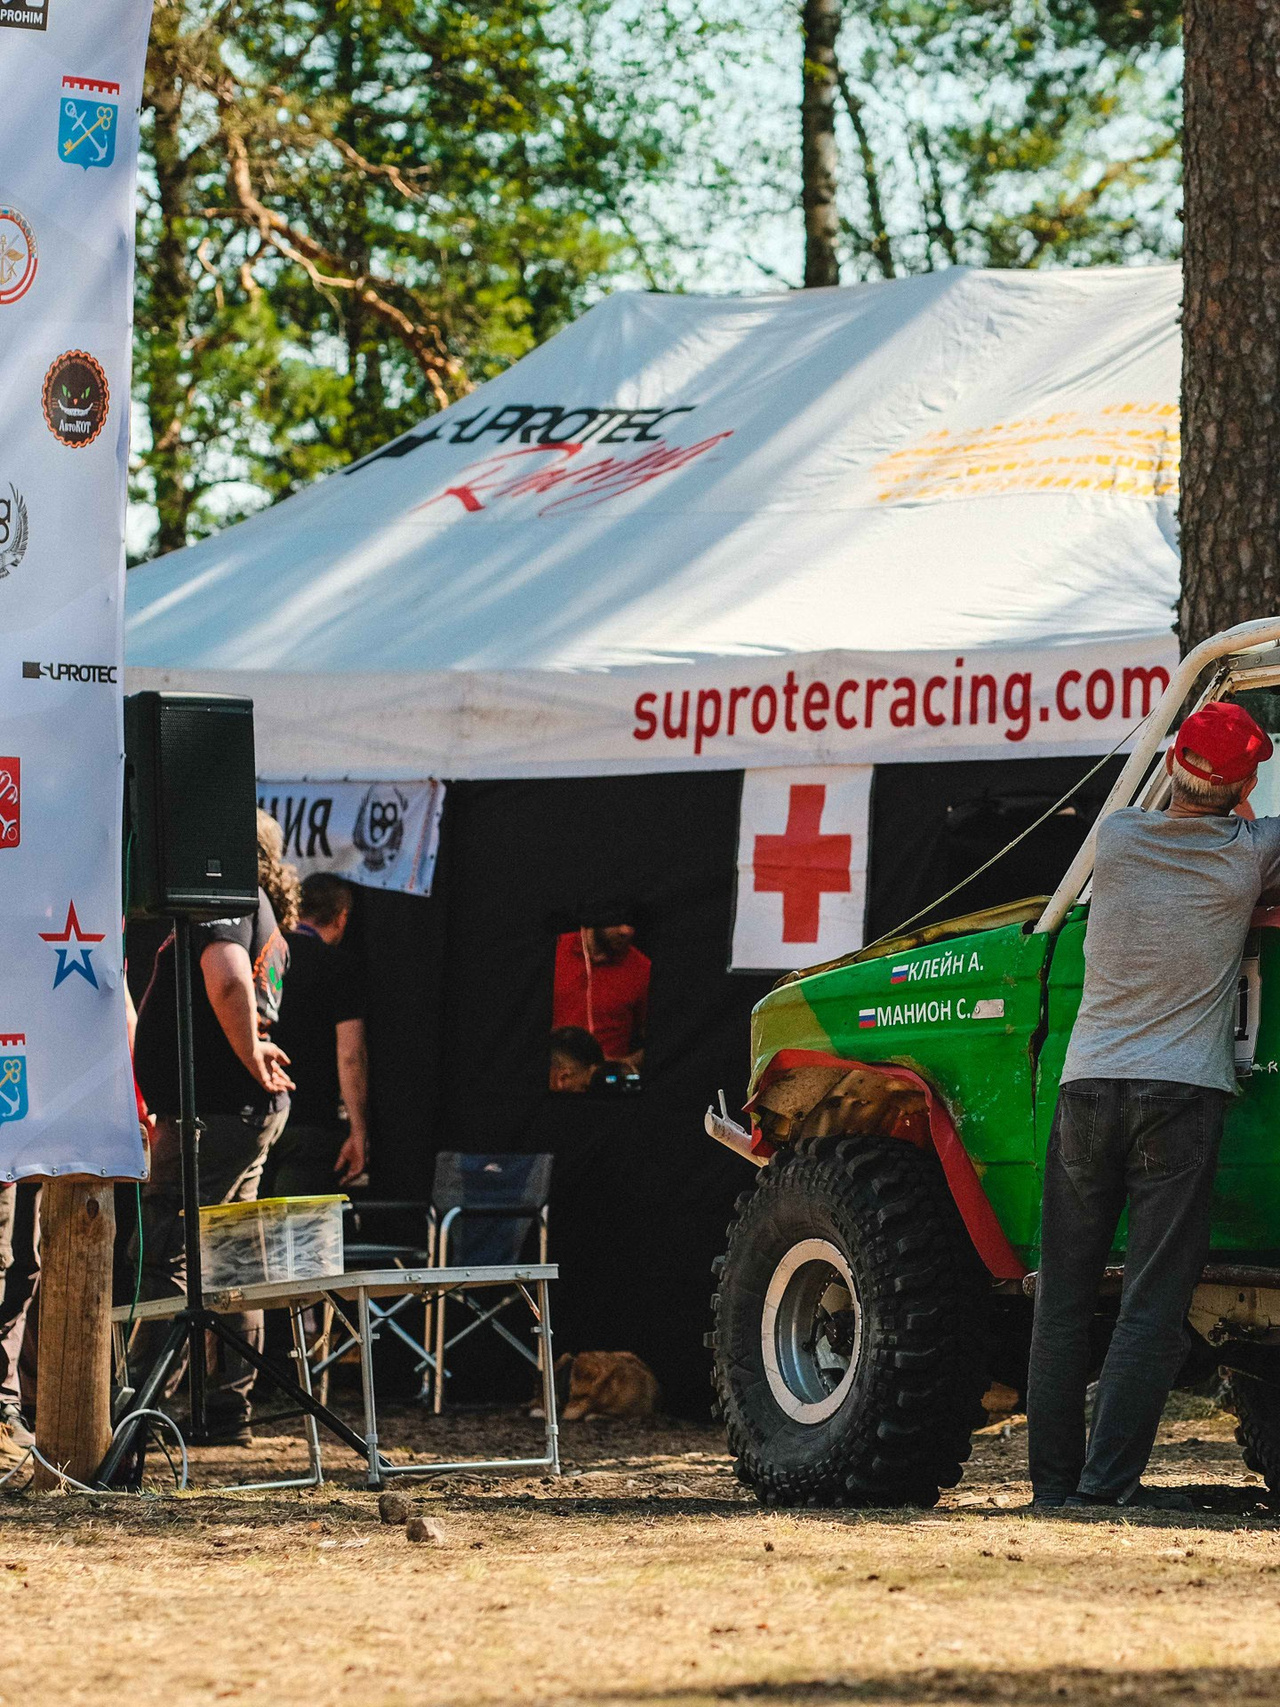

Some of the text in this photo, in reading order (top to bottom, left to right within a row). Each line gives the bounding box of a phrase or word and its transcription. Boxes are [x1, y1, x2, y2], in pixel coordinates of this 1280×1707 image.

[38, 661, 117, 684] SUPROTEC
[633, 657, 1170, 754] suprotecracing.com
[907, 951, 984, 982] КЛЕЙН А.
[877, 998, 971, 1027] МАНИОН С.
